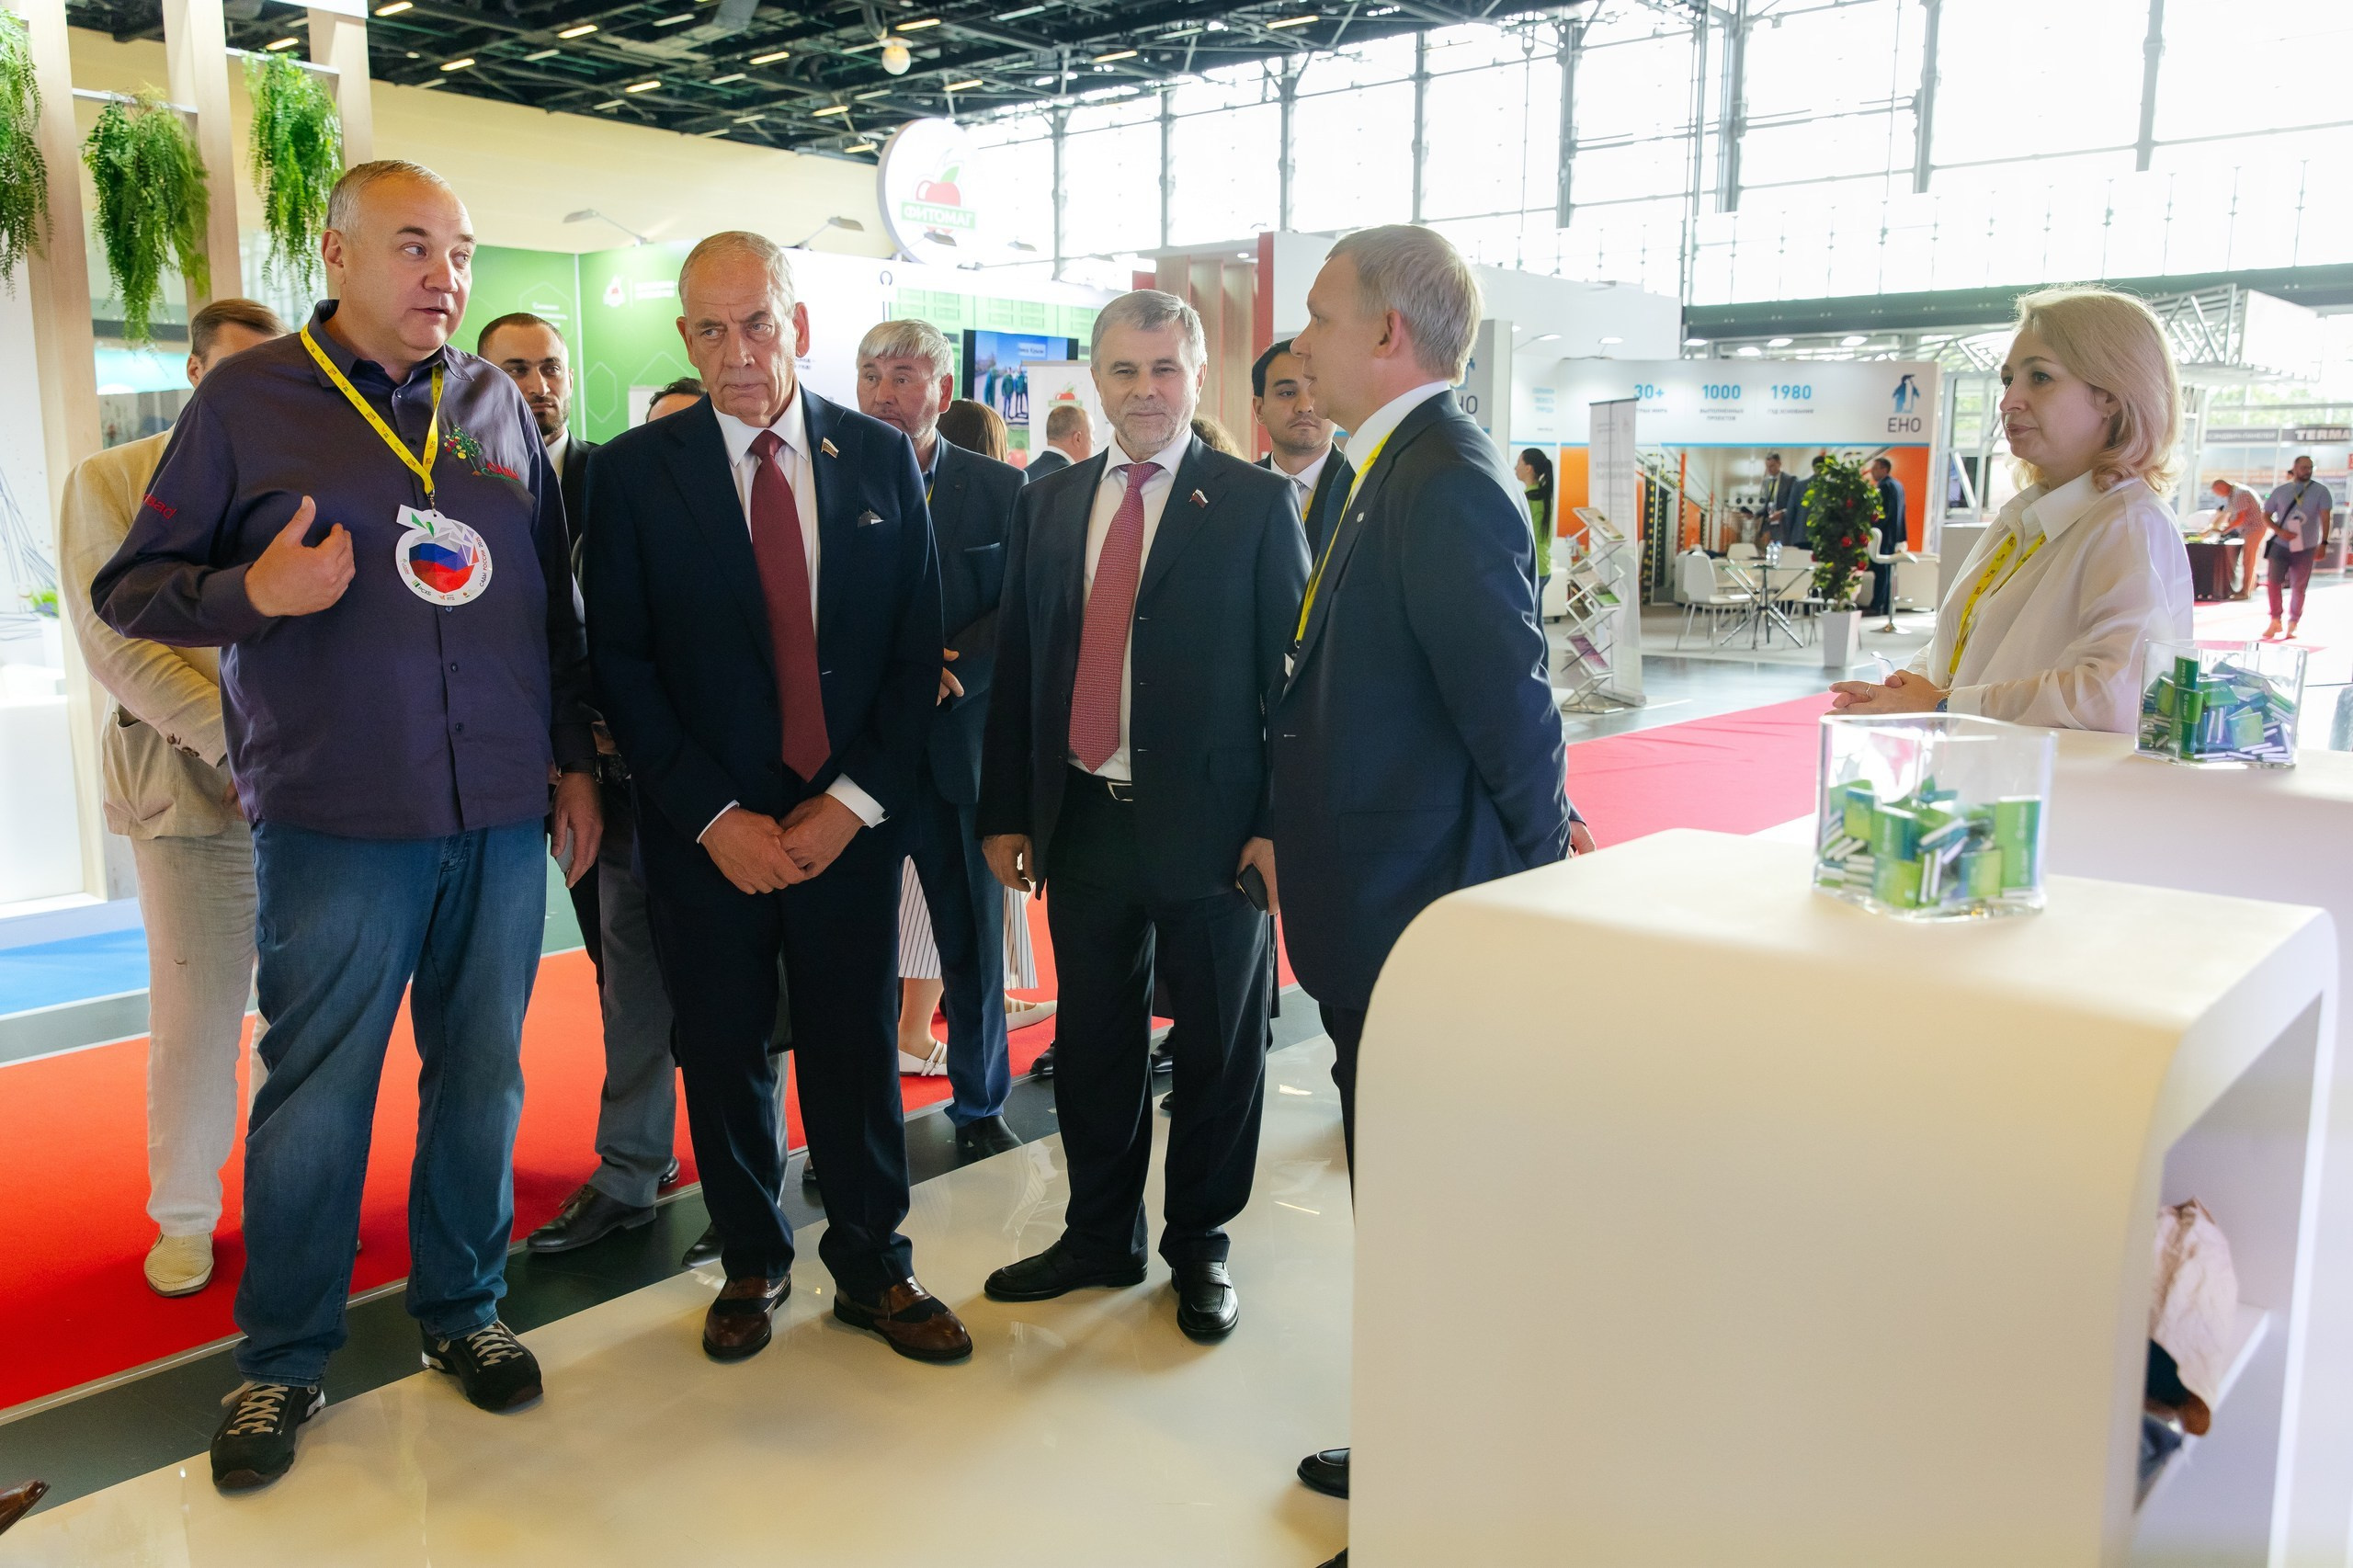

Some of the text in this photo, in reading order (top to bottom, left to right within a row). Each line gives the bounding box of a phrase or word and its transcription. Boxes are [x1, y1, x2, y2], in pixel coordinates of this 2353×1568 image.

[903, 205, 972, 227] ФИТОМАГ
[1633, 384, 1665, 399] 30+
[1702, 384, 1742, 400] 1000
[1770, 385, 1812, 400] 1980
[479, 573, 487, 587] САДЫ
[418, 586, 432, 596] РСХБ
